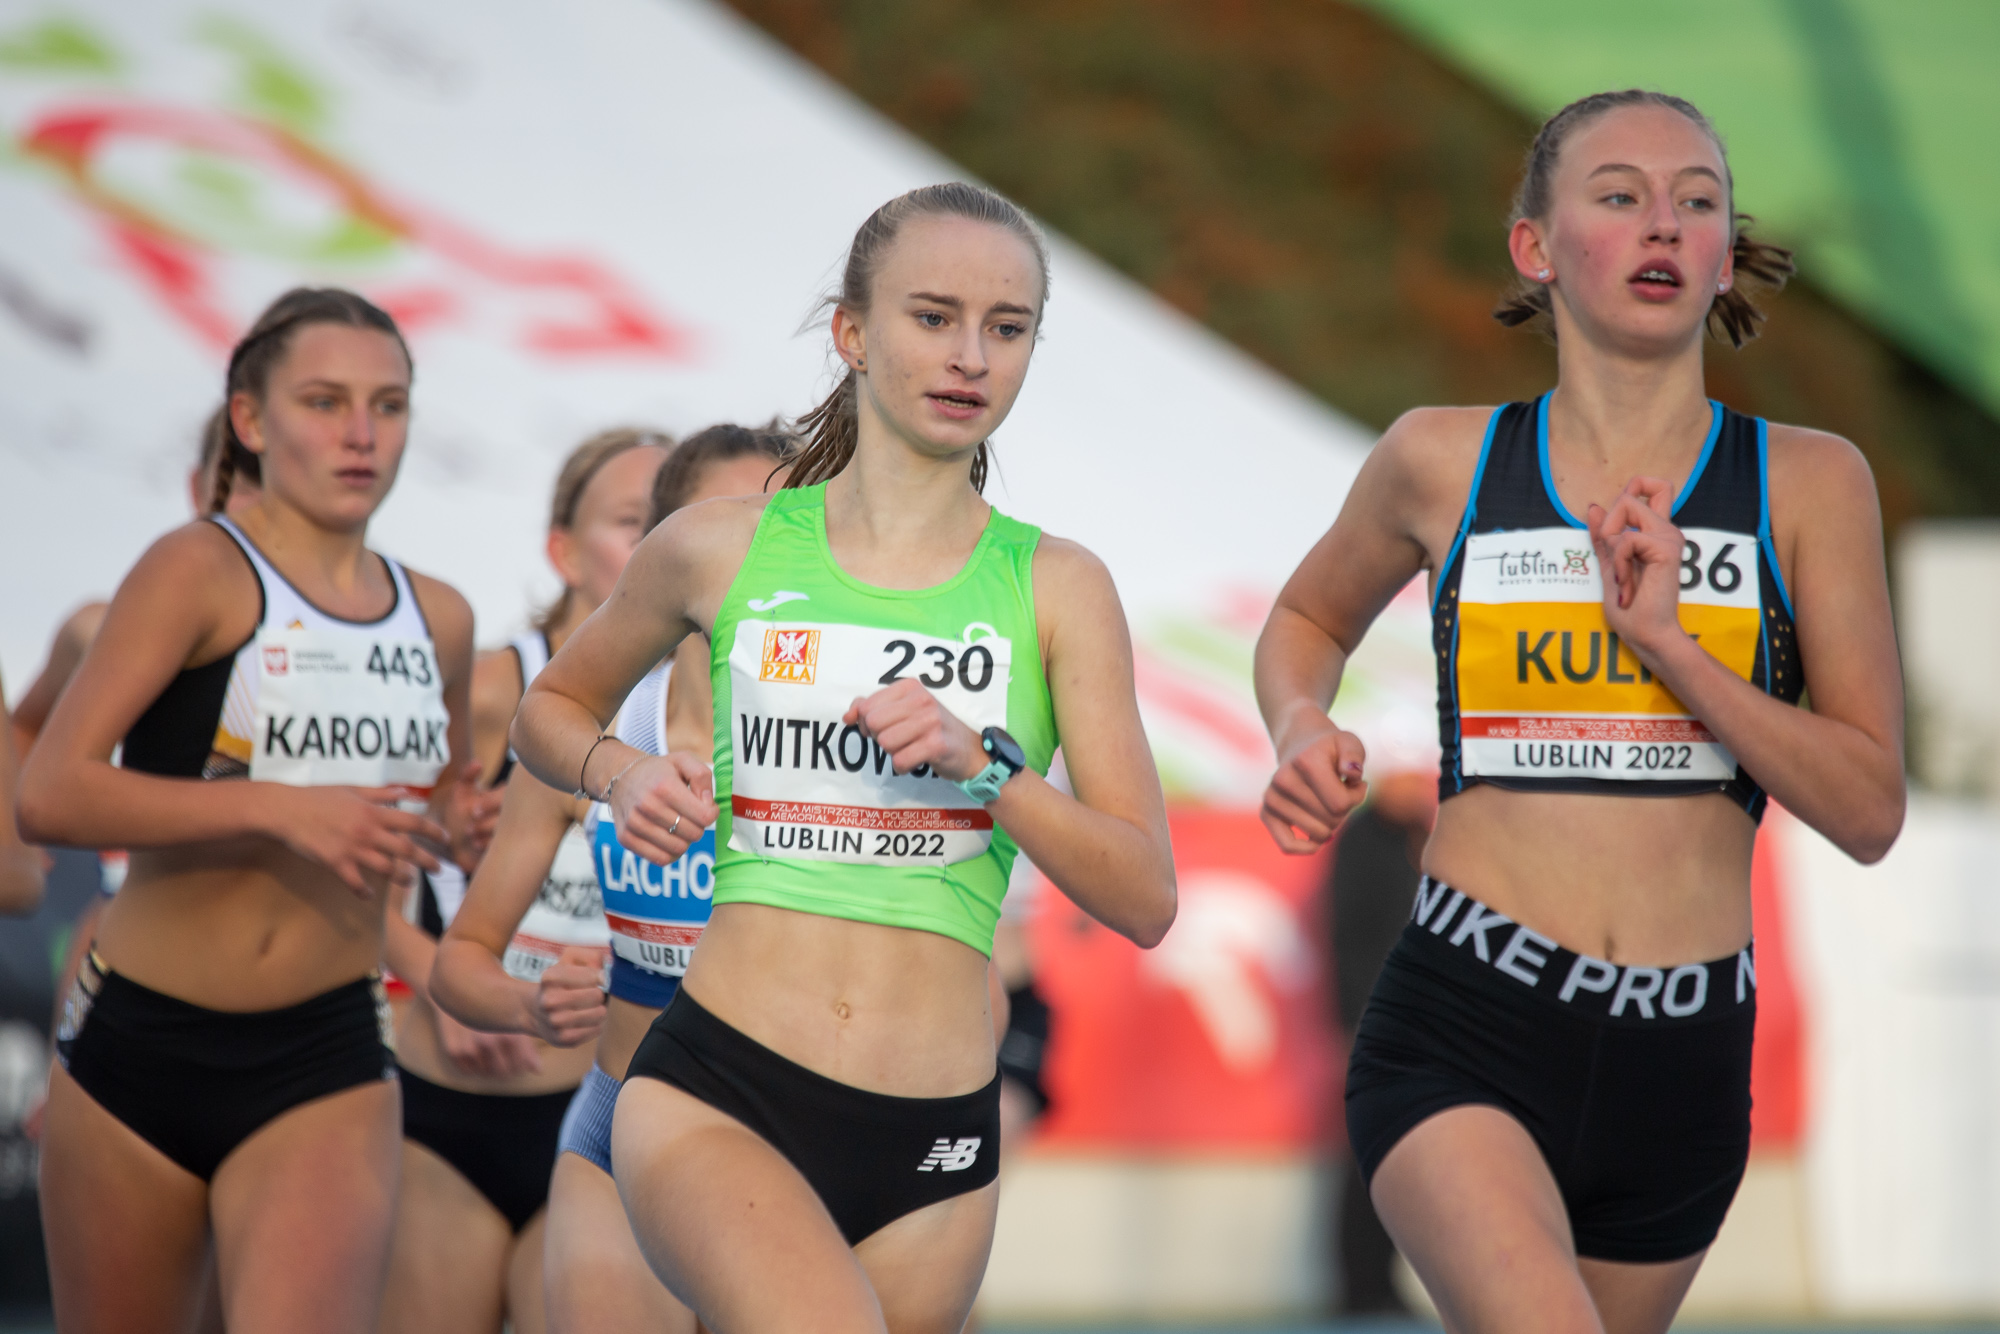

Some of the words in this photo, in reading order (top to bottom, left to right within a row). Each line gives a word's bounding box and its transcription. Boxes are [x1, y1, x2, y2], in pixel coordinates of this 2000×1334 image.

[366, 644, 433, 687] 443
[761, 662, 813, 683] PZLA
[878, 640, 994, 692] 230
[265, 714, 445, 762] KAROLAK
[1513, 743, 1613, 769] LUBLIN
[1626, 745, 1692, 770] 2022
[744, 808, 768, 819] MAŁY
[770, 811, 829, 824] MEMORIAŁ
[832, 816, 885, 829] JANUSZA
[770, 803, 799, 813] PZLA
[801, 804, 881, 819] MISTRZOSTWA
[882, 810, 919, 820] POLSKI
[921, 811, 941, 820] U16
[763, 825, 863, 854] LUBLIN
[873, 833, 945, 857] 2022
[638, 941, 695, 969] LUBL
[1411, 873, 1560, 987] NIKE
[1558, 954, 1710, 1020] PRO
